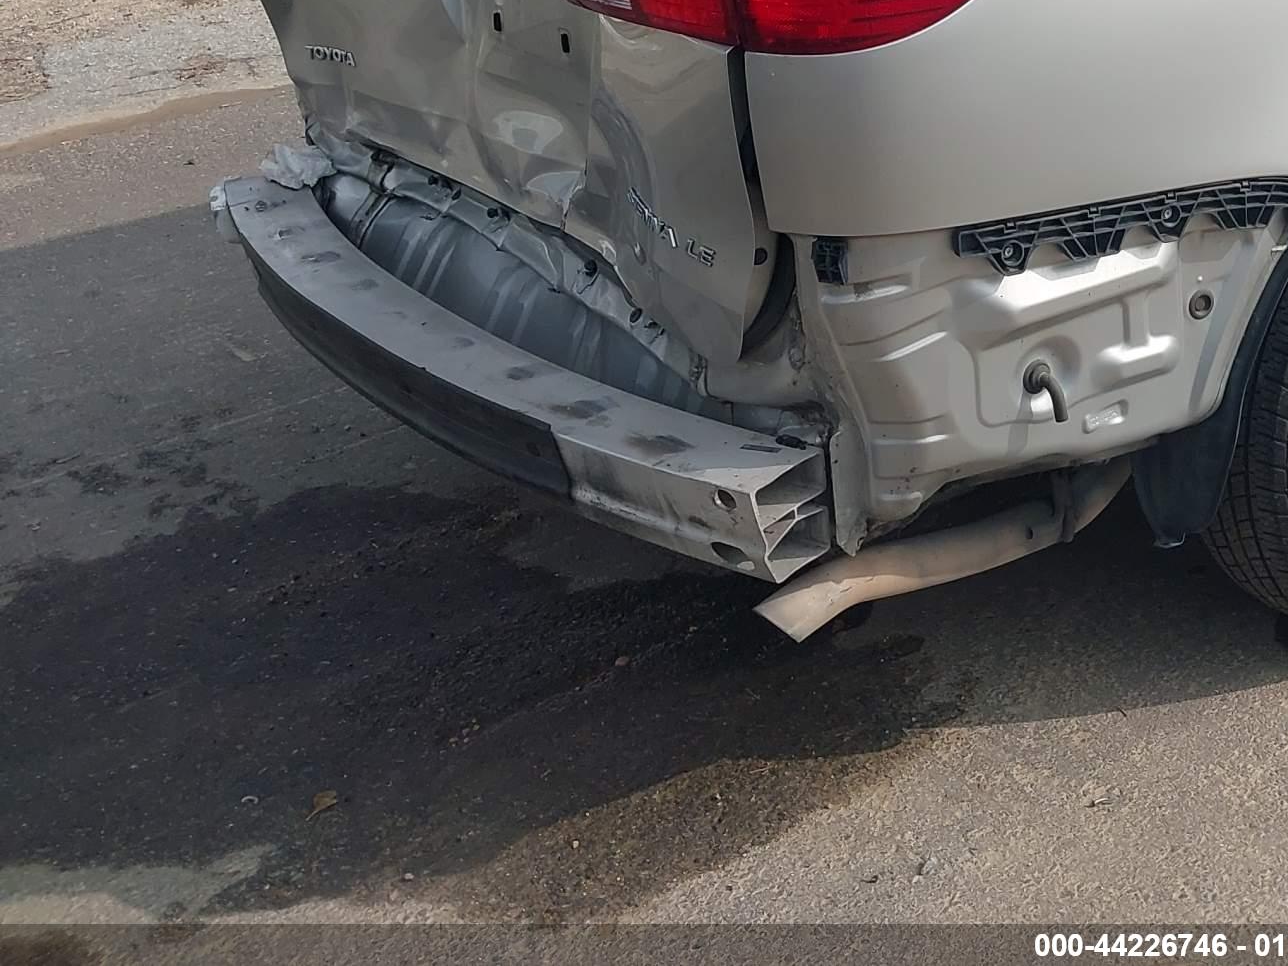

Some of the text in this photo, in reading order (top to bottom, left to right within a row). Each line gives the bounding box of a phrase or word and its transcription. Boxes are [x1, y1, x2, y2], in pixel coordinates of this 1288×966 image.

[304, 44, 356, 67] TOYOTA
[626, 187, 717, 268] ENNA LE
